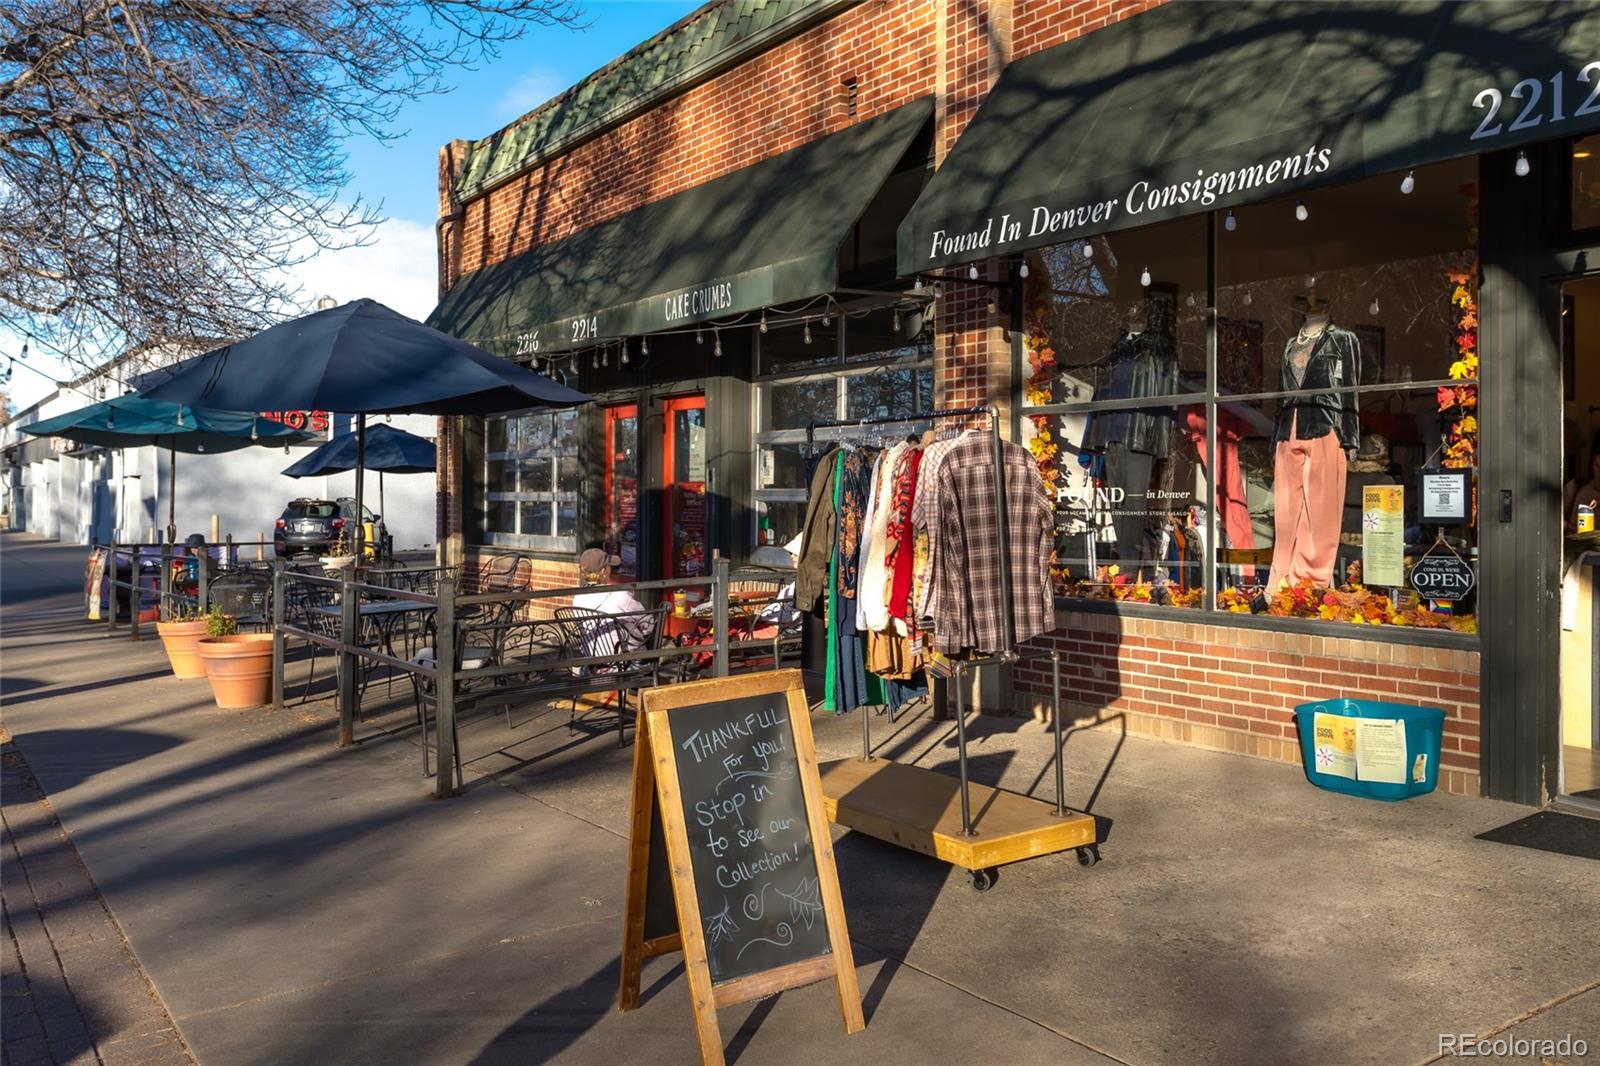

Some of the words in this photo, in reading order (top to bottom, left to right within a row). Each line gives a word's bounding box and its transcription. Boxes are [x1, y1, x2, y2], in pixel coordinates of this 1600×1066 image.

[1469, 60, 1600, 141] 2212
[928, 218, 993, 259] Found
[997, 213, 1022, 245] In
[1027, 198, 1119, 238] Denver
[1124, 144, 1332, 215] Consignments
[664, 293, 690, 321] CAKE
[691, 281, 733, 315] CRUMBS
[515, 330, 540, 356] 2216
[571, 315, 598, 343] 2214
[1056, 486, 1125, 503] FOND
[1146, 489, 1156, 499] in
[1157, 489, 1191, 499] Denver
[1413, 572, 1471, 587] OPEN
[681, 708, 787, 763] THANKFUL
[695, 792, 746, 827] Stop
[751, 784, 776, 802] in
[706, 828, 729, 857] to
[769, 818, 796, 833] our
